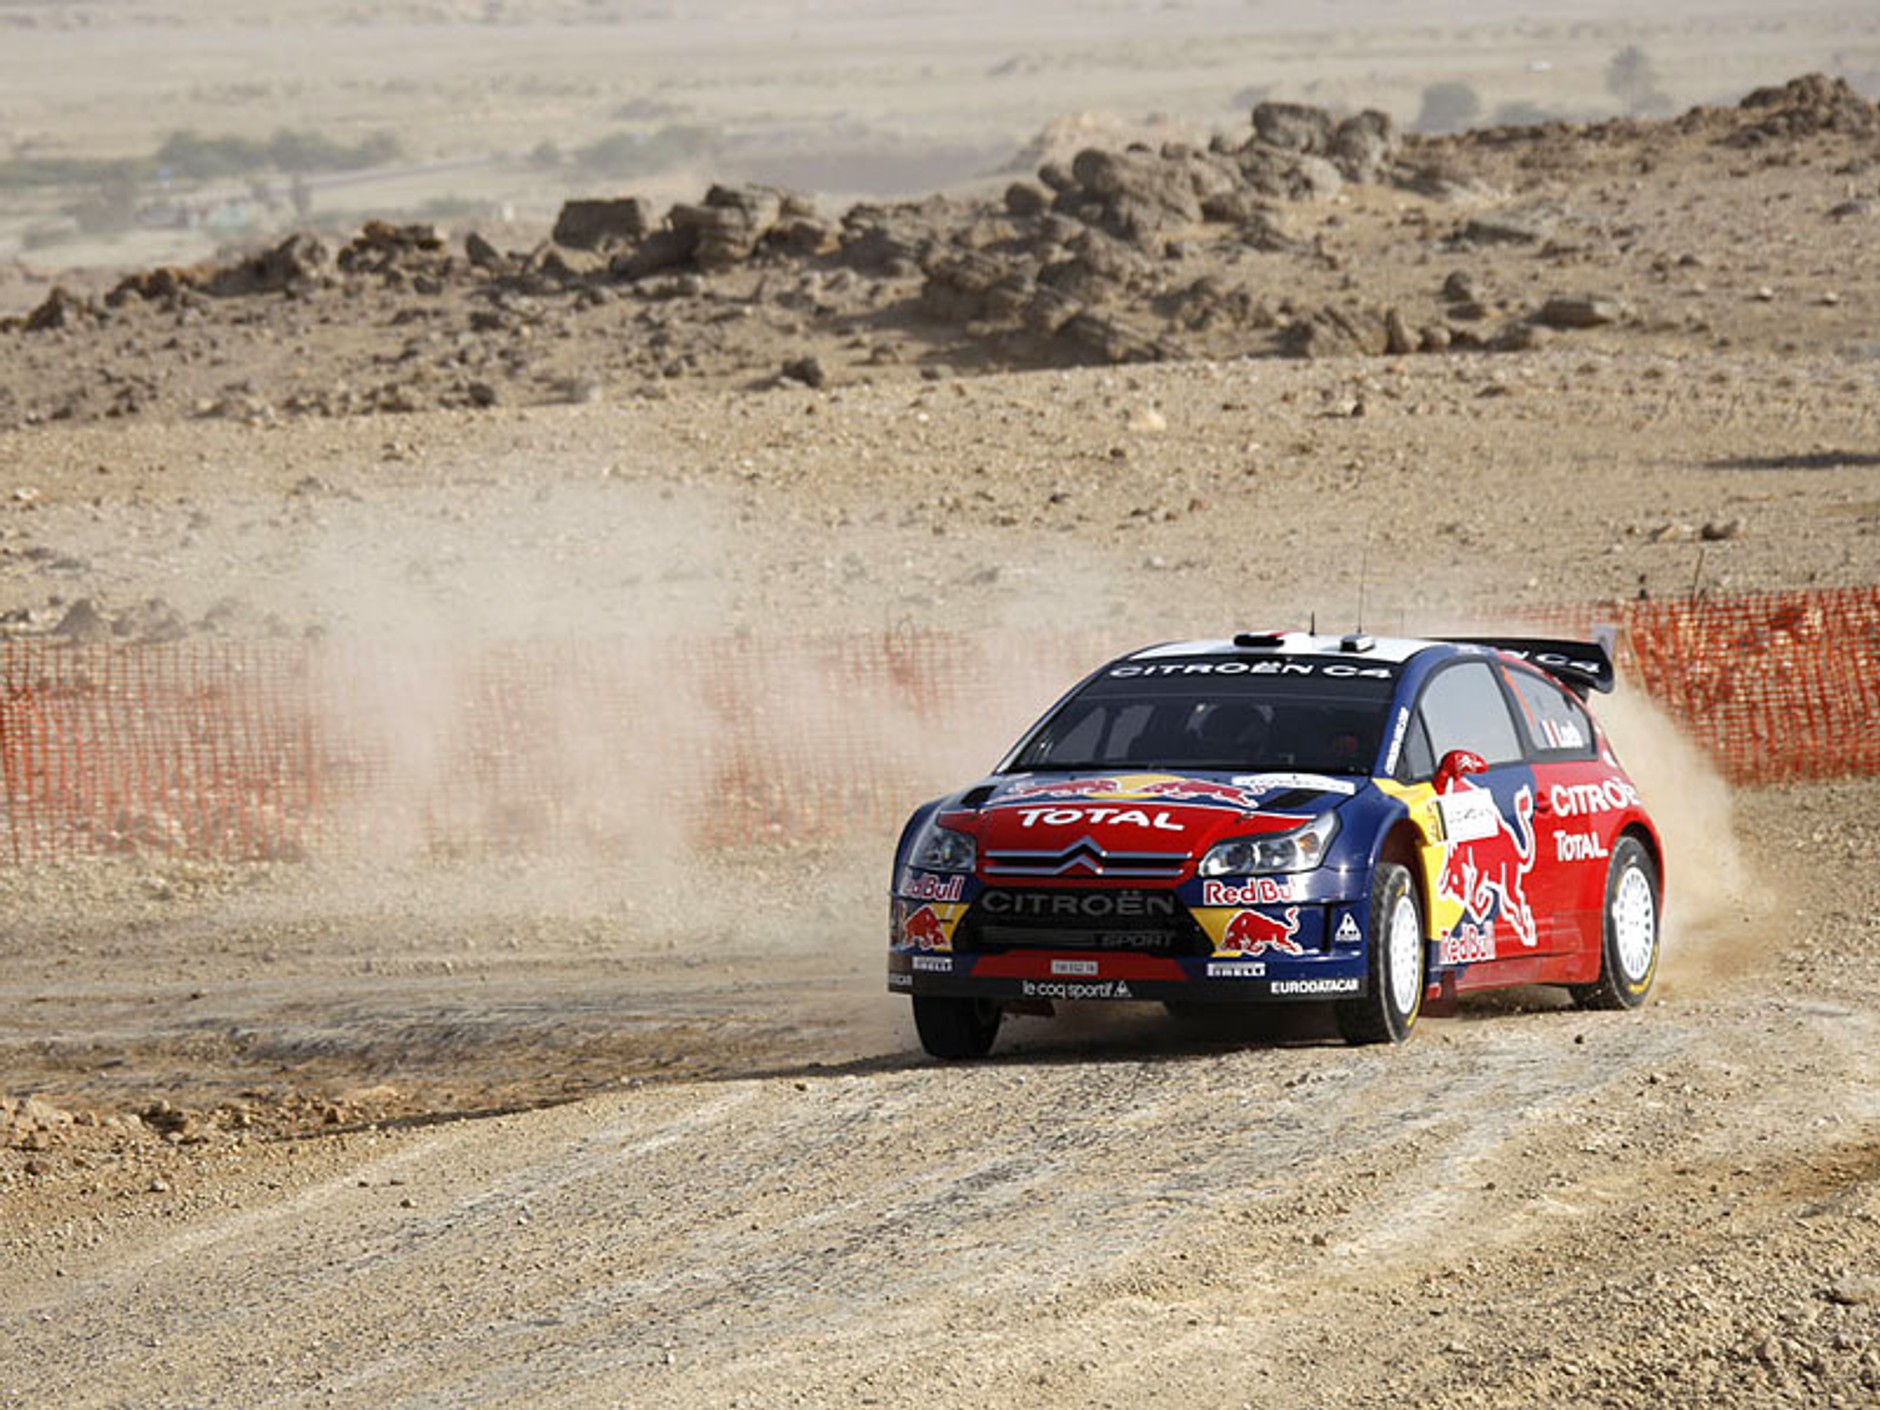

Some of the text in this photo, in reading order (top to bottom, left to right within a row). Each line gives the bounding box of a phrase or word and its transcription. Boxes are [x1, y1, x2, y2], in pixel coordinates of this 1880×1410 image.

[1322, 665, 1392, 678] C4
[1017, 808, 1185, 831] TOTAL
[1553, 830, 1609, 861] TOTAL
[981, 889, 1174, 916] CITROËN
[1067, 980, 1112, 999] sportif
